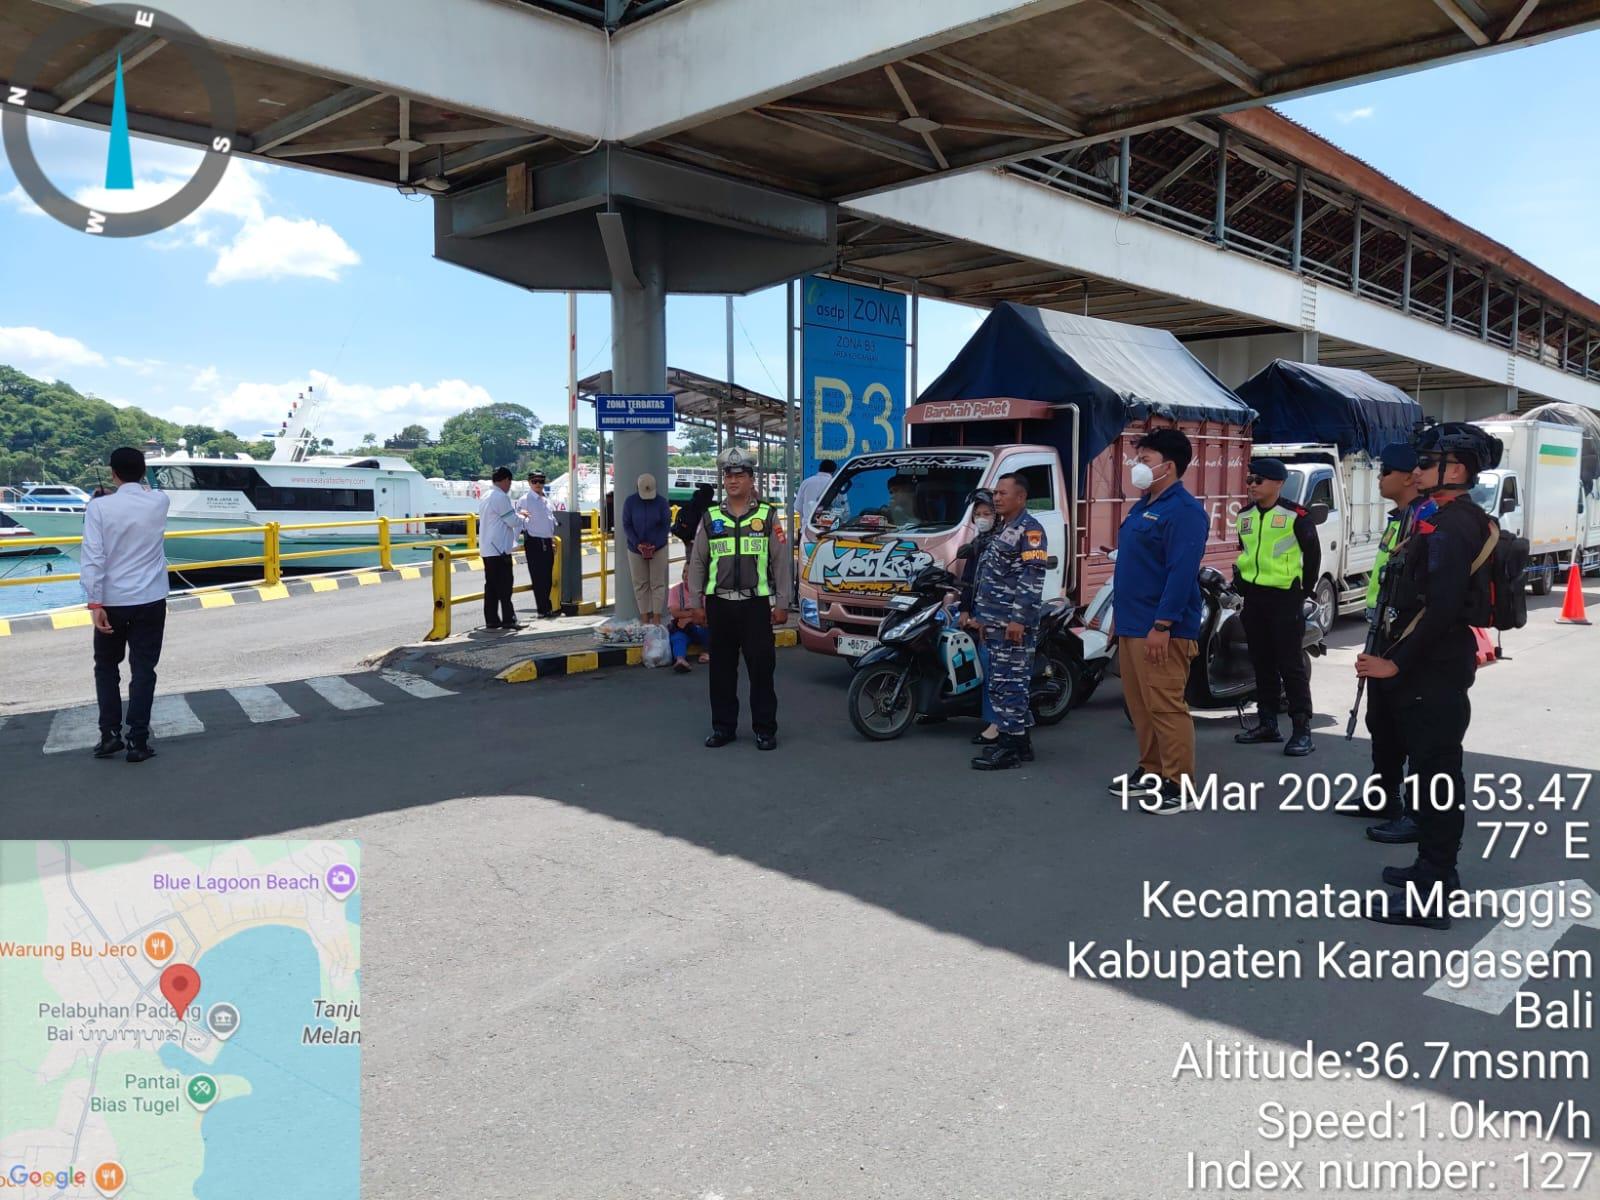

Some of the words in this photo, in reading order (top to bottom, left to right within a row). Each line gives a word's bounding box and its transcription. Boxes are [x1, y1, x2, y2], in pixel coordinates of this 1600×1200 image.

[854, 297, 903, 328] ZONA
[606, 400, 626, 409] ZONA
[627, 400, 665, 409] TERBATAS
[814, 375, 895, 460] B3
[924, 404, 972, 421] Barokah
[974, 400, 1010, 418] Paket
